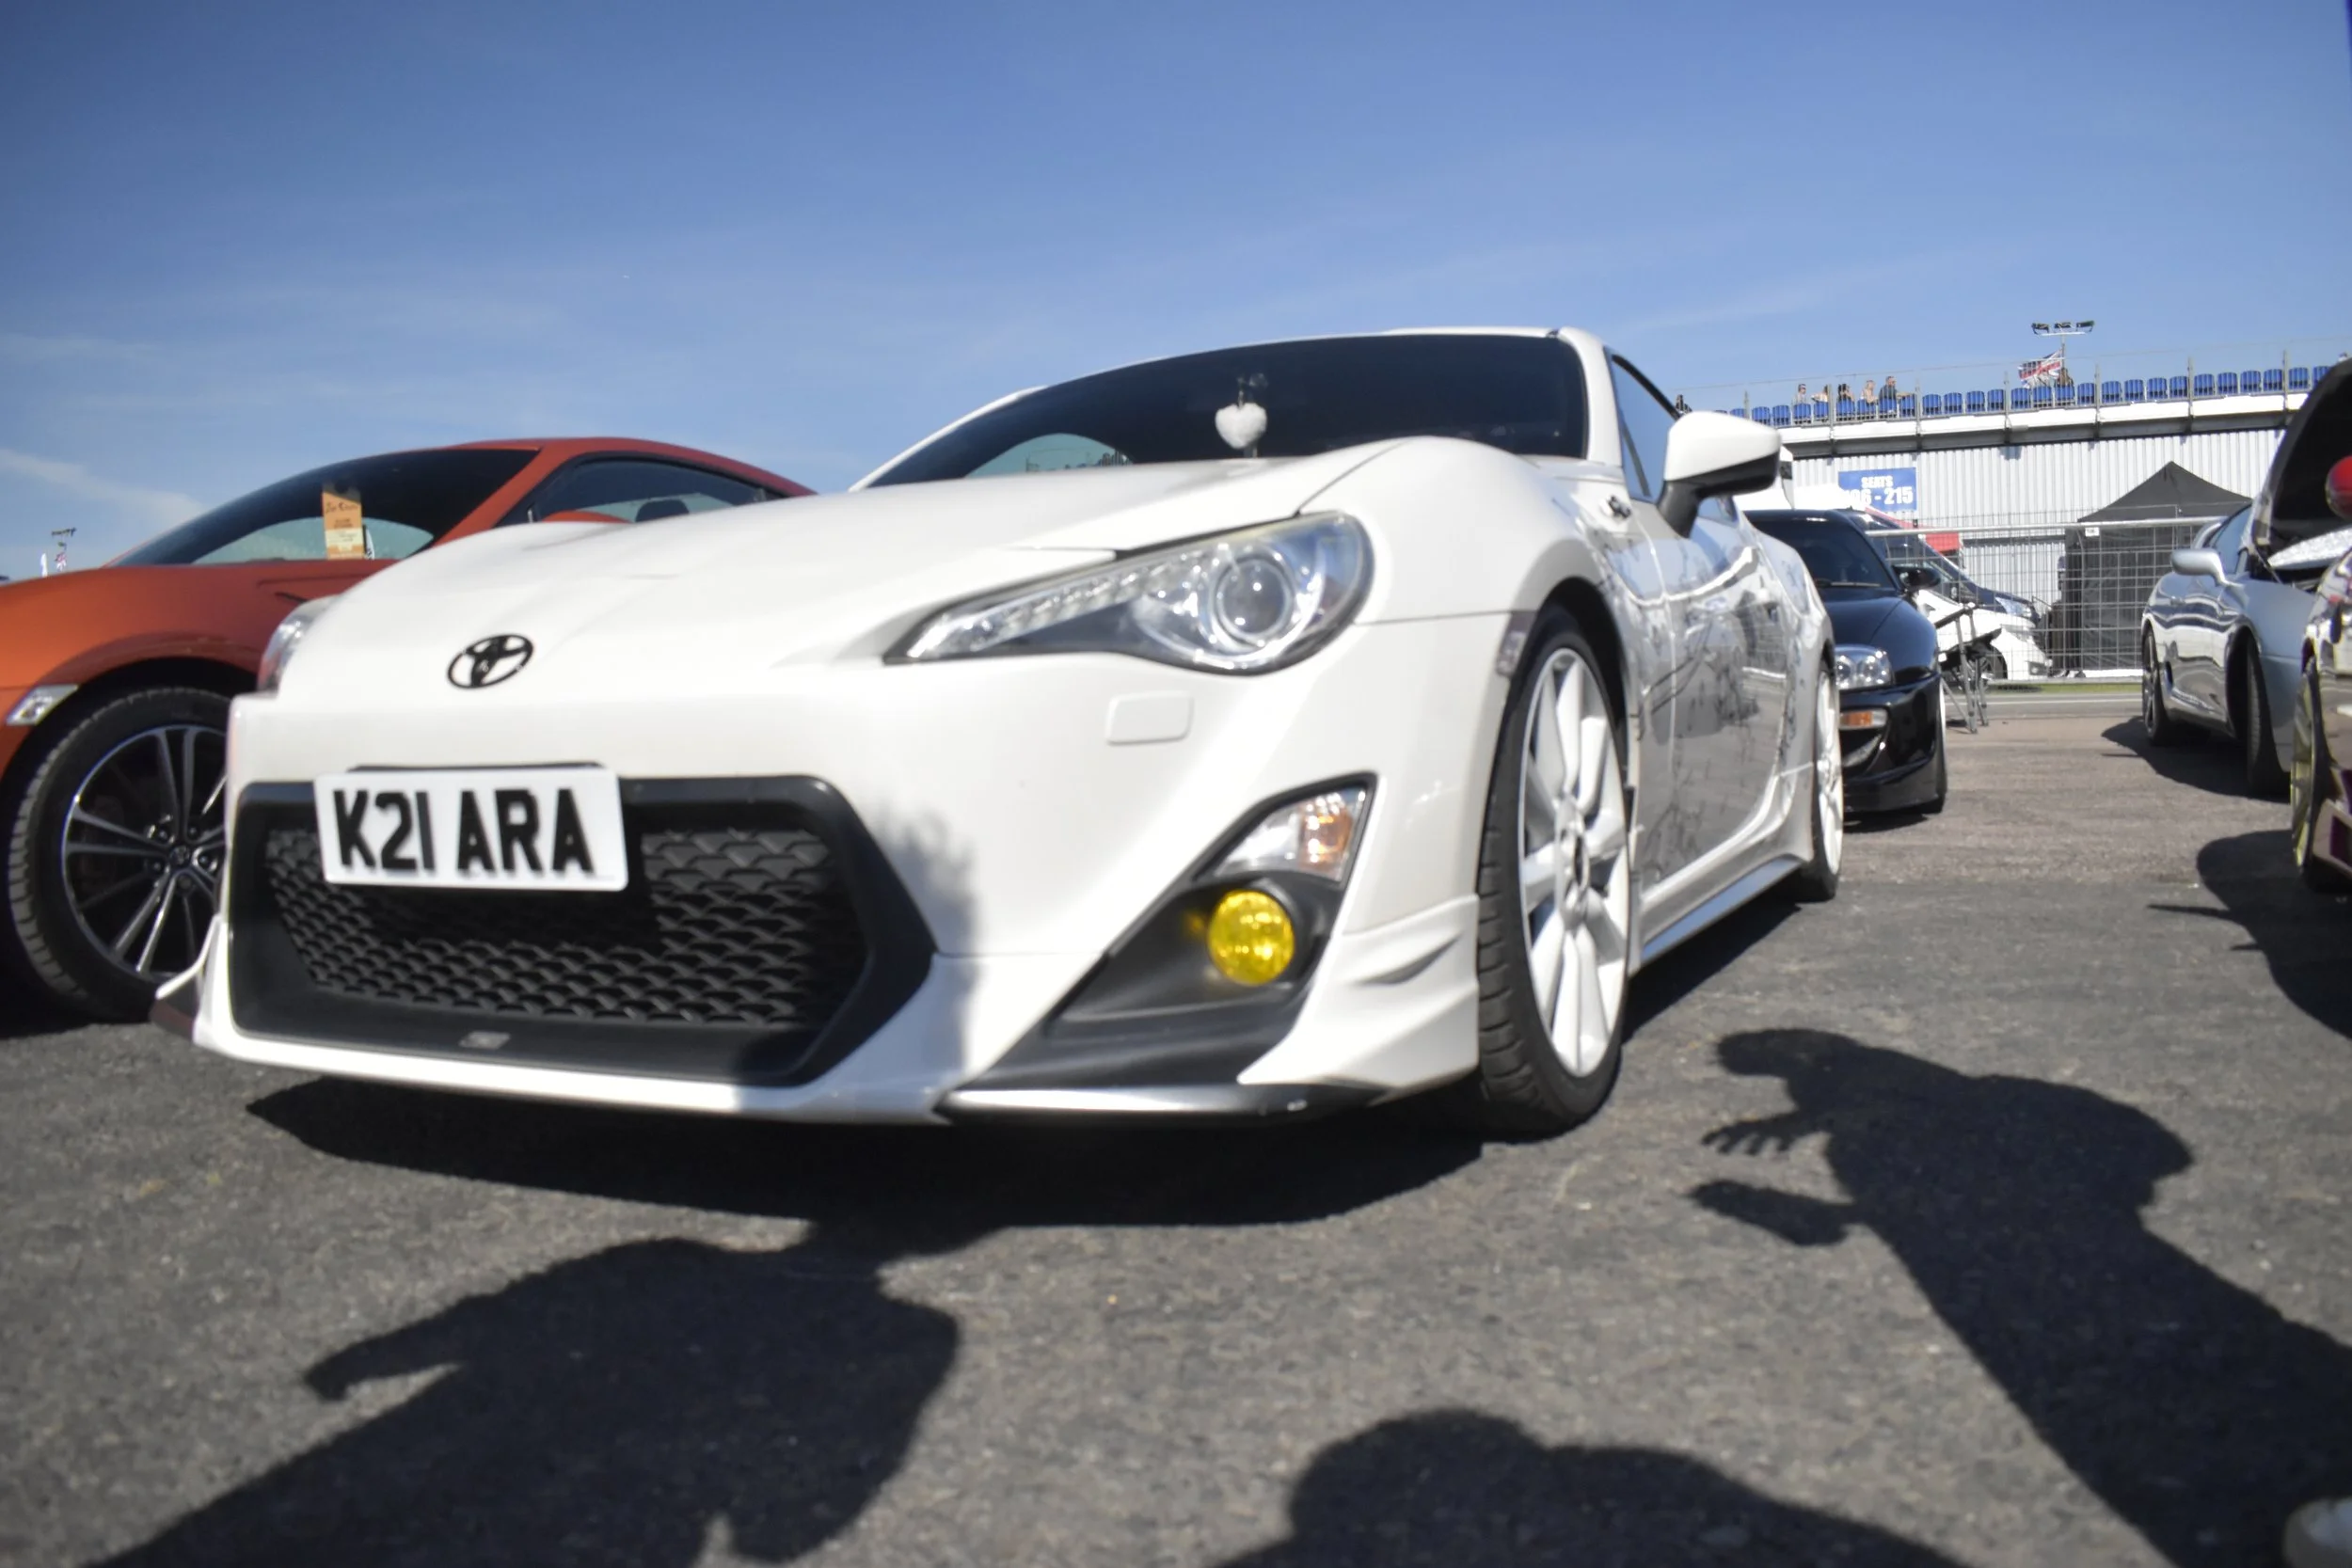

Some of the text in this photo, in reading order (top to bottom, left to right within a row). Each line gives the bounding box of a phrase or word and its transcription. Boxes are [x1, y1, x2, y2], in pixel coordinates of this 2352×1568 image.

[1861, 475, 1893, 488] SEATS
[1883, 486, 1914, 505] 215
[333, 787, 595, 874] K21 ARA
